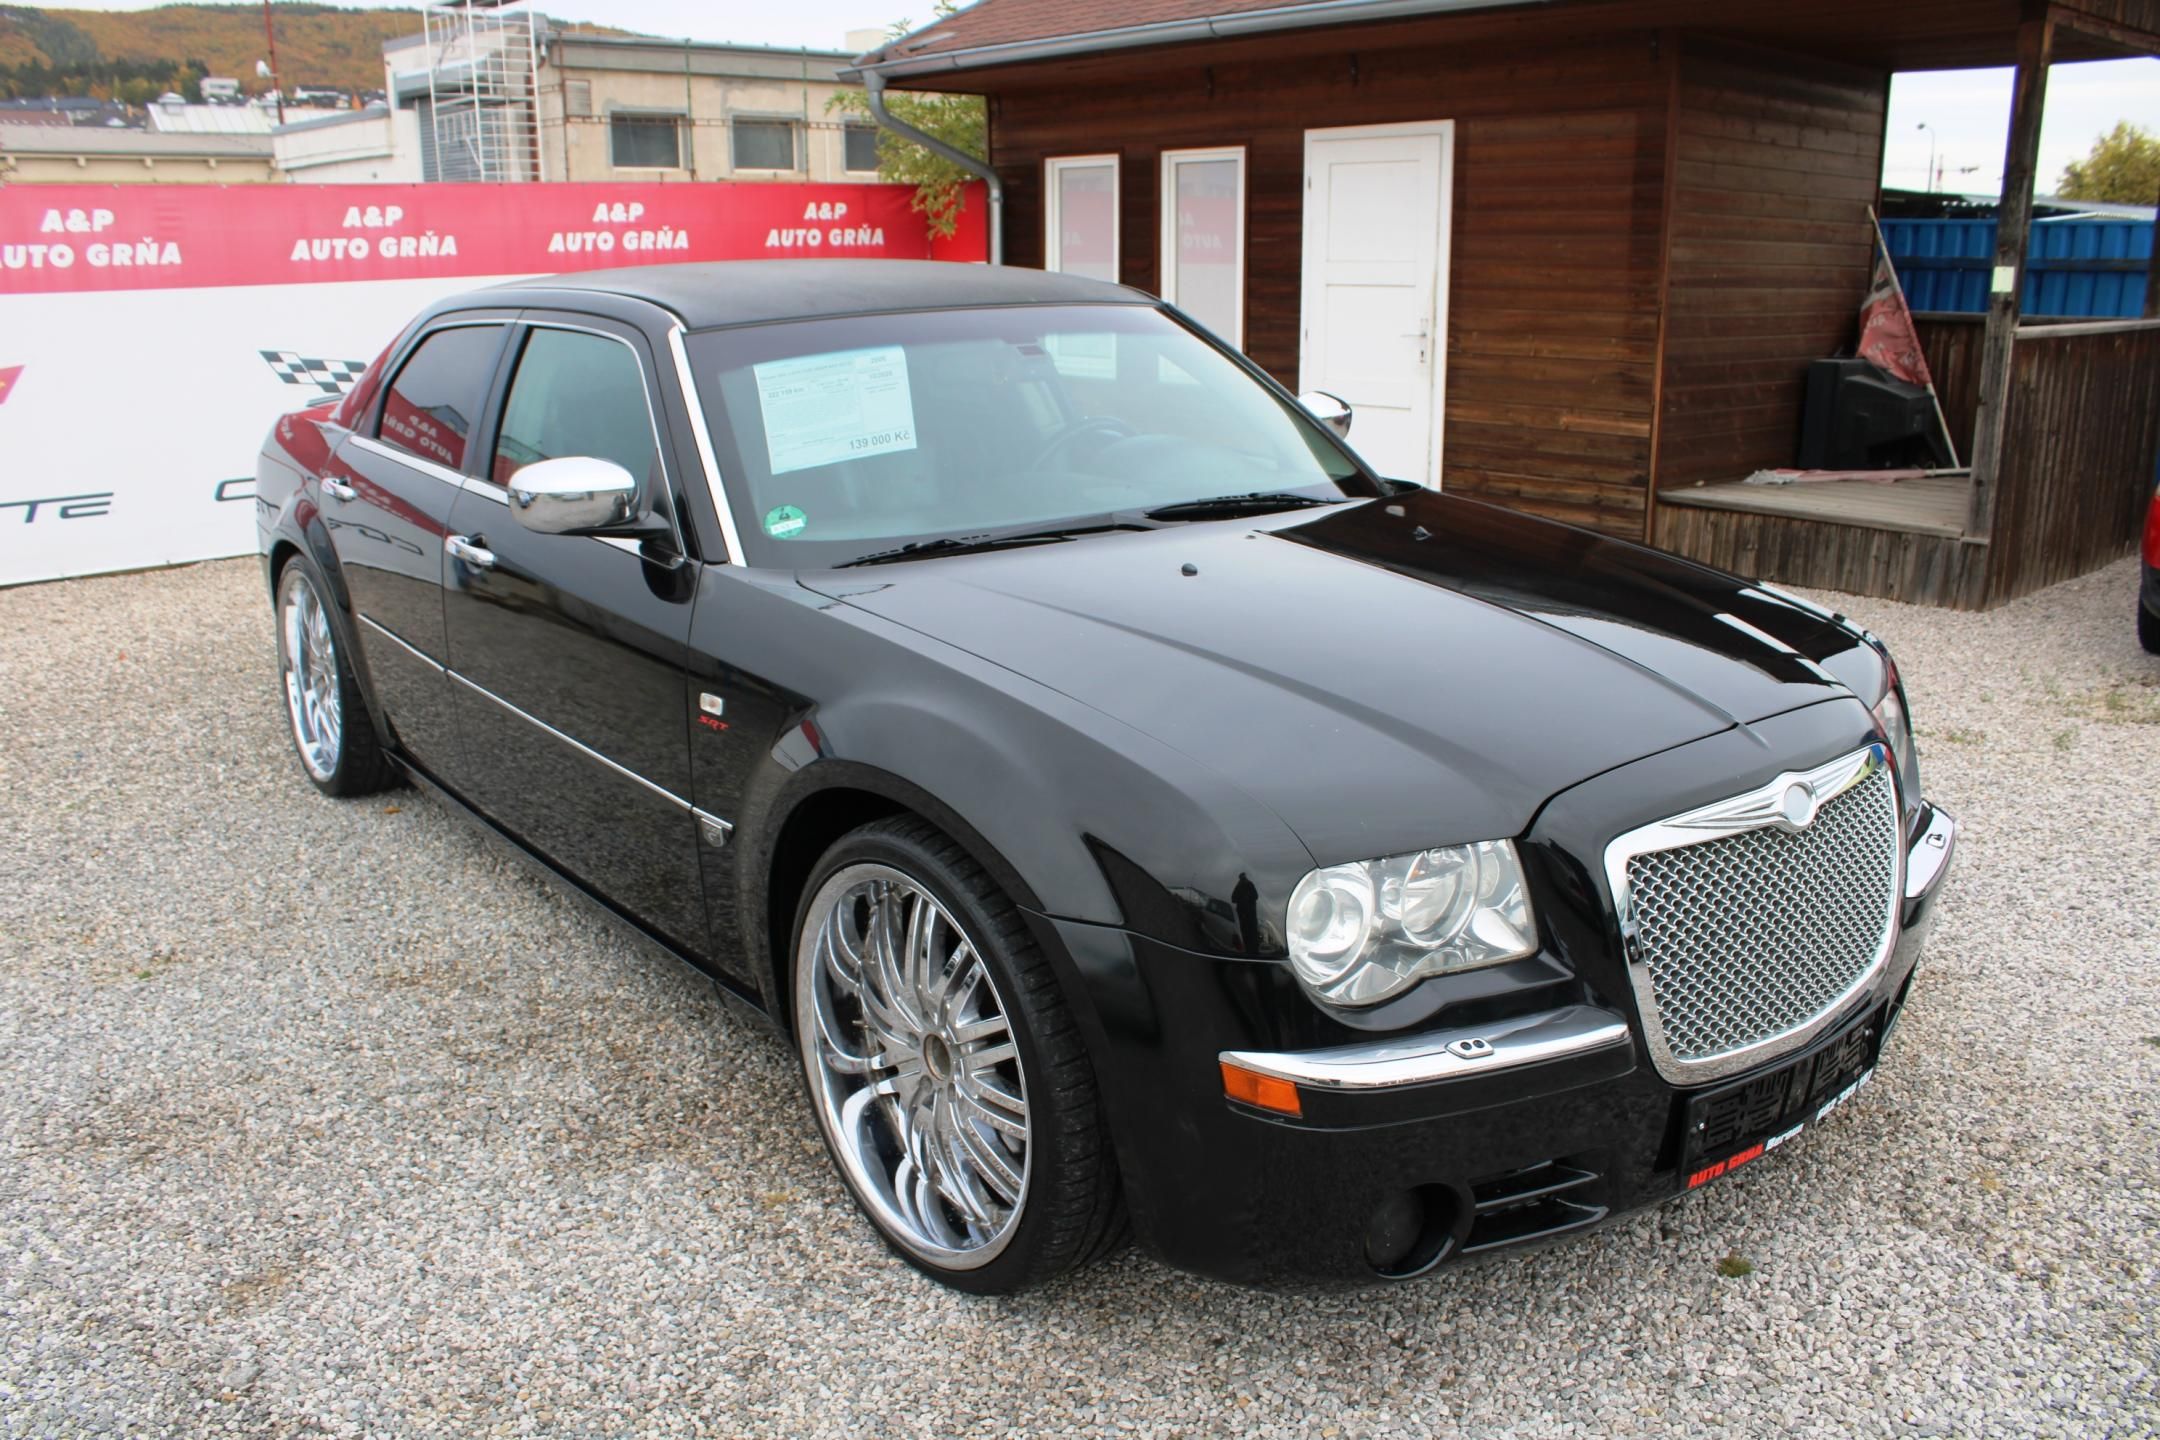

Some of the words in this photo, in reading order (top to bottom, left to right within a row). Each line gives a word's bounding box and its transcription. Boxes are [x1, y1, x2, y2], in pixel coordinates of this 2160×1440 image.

[41, 209, 114, 232] A&P
[342, 206, 404, 228] A&P
[593, 203, 644, 222] A&P
[804, 202, 847, 220] A&P
[290, 237, 369, 261] AUTO
[379, 230, 458, 258] GRŇA
[547, 231, 615, 252] AUTO
[622, 226, 689, 250] GRŇA
[765, 228, 822, 247] AUTO
[828, 224, 884, 246] GRŇA
[0, 243, 74, 269] UTO
[86, 236, 182, 267] GRŇA
[850, 438, 869, 449] 139
[871, 433, 891, 446] 000
[894, 430, 911, 442] Kč
[1687, 1161, 1727, 1190] AUTO
